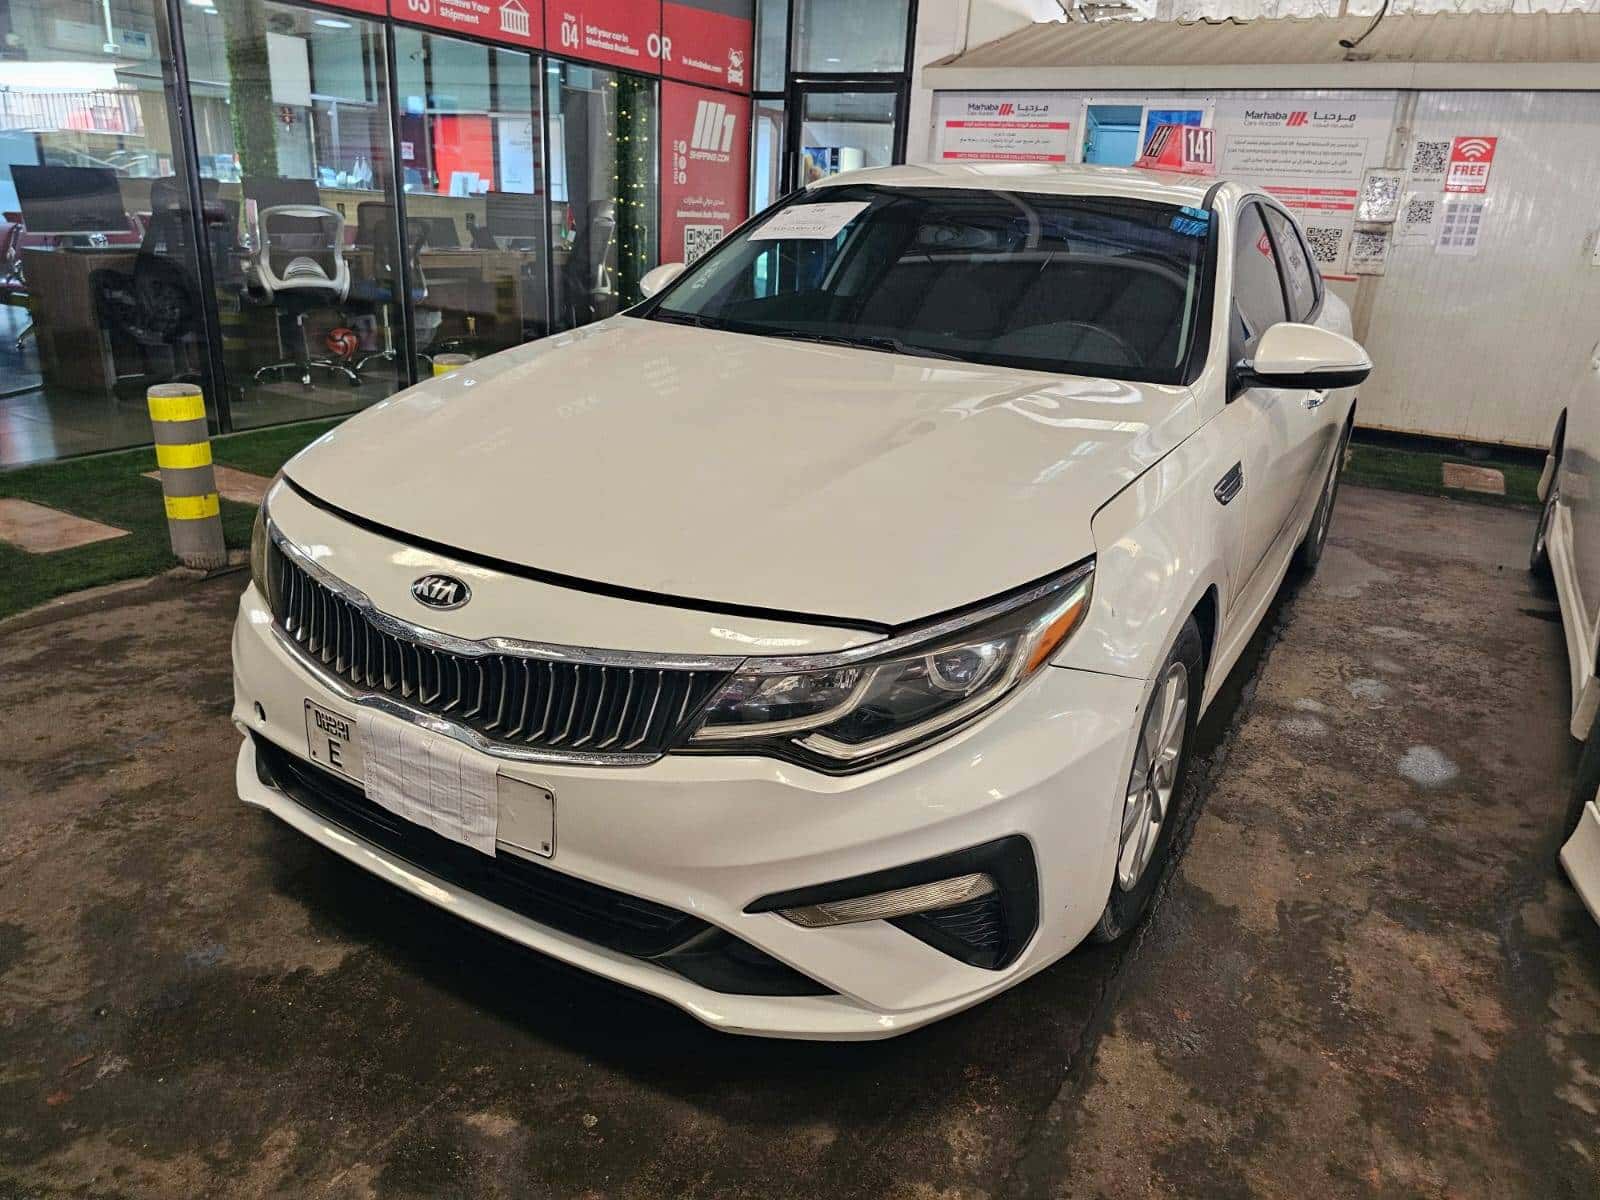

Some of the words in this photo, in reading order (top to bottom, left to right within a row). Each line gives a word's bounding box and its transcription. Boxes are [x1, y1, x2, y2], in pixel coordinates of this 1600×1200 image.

[440, 7, 480, 25] Shipment
[561, 22, 579, 50] 04
[647, 33, 672, 62] OR
[967, 103, 998, 112] Marhaba
[1244, 110, 1288, 121] Marhaba
[1313, 111, 1357, 123] مرحبا
[1188, 129, 1212, 164] 141
[1453, 165, 1485, 177] FREE
[415, 576, 458, 604] KIA
[328, 739, 343, 767] E
